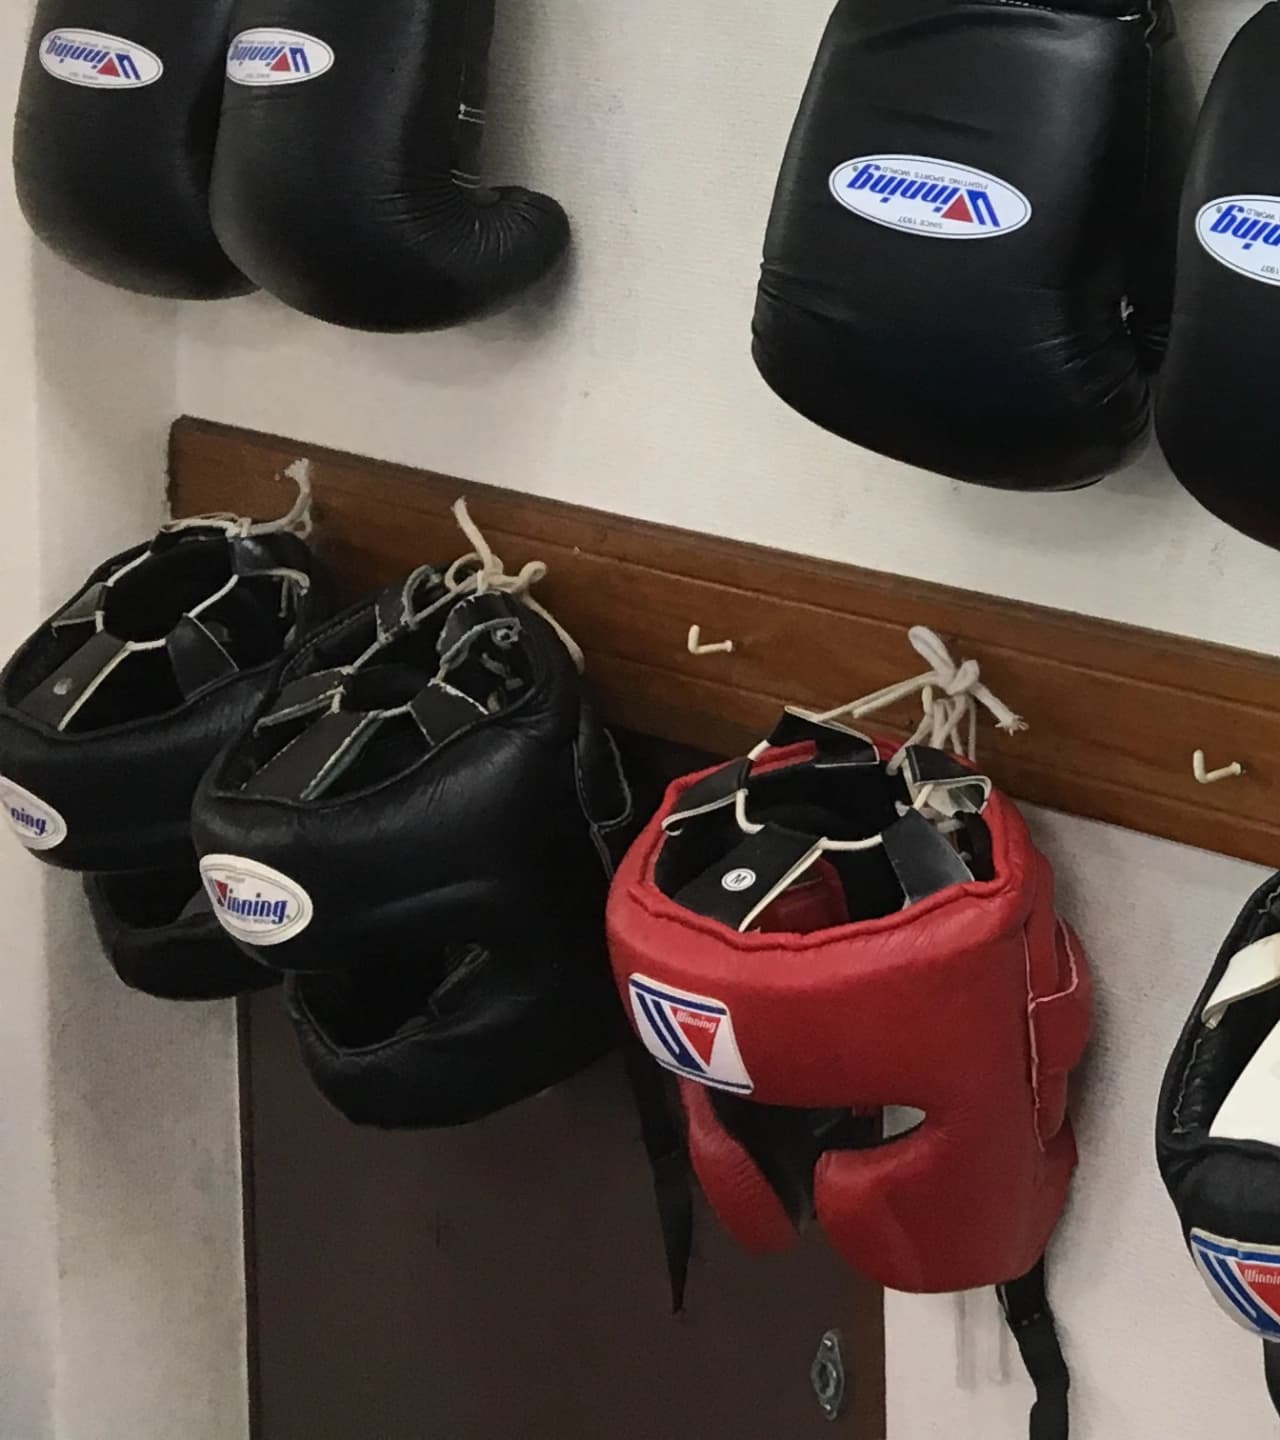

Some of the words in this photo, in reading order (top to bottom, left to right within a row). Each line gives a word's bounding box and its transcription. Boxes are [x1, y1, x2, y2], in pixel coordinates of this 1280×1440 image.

[45, 35, 142, 81] Winning
[846, 163, 1001, 228] Winning
[1246, 208, 1276, 221] WORLD
[1260, 264, 1280, 276] 1937
[10, 807, 47, 836] ning
[676, 1009, 717, 1034] Winning
